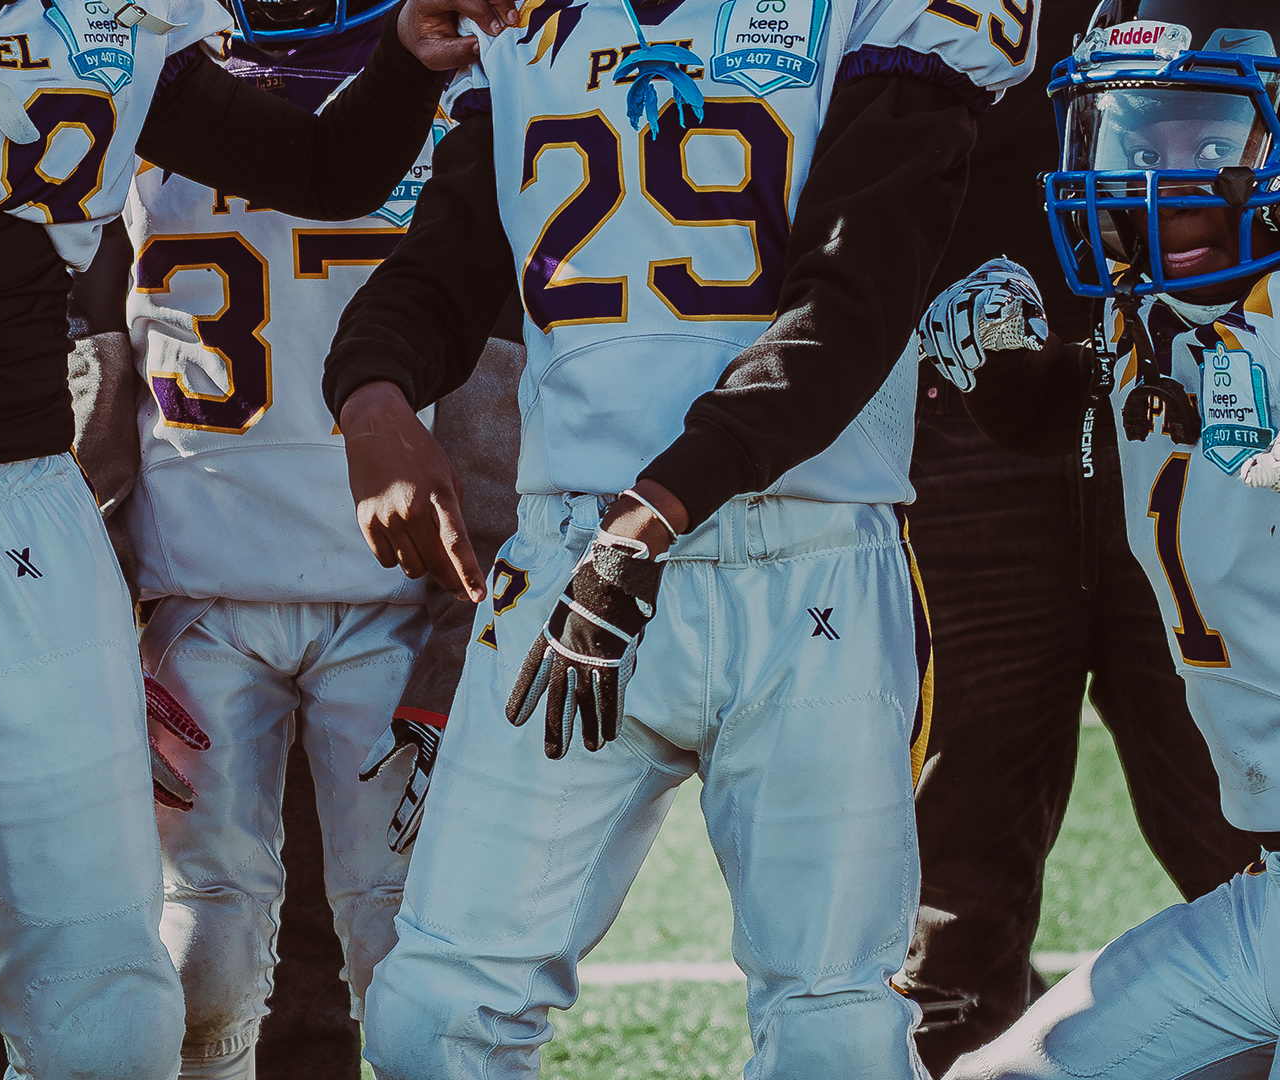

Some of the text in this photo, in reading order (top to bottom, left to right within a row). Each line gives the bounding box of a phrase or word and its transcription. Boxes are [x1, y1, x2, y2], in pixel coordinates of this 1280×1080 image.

[86, 18, 118, 32] keep
[748, 17, 789, 32] keep
[1109, 26, 1165, 46] Riddell
[84, 54, 99, 66] by
[101, 52, 116, 63] 407
[726, 53, 802, 71] by 407 ETR
[520, 96, 794, 336] 29
[1212, 390, 1238, 407] keep
[1235, 431, 1259, 443] ETR
[1148, 452, 1231, 668] 1
